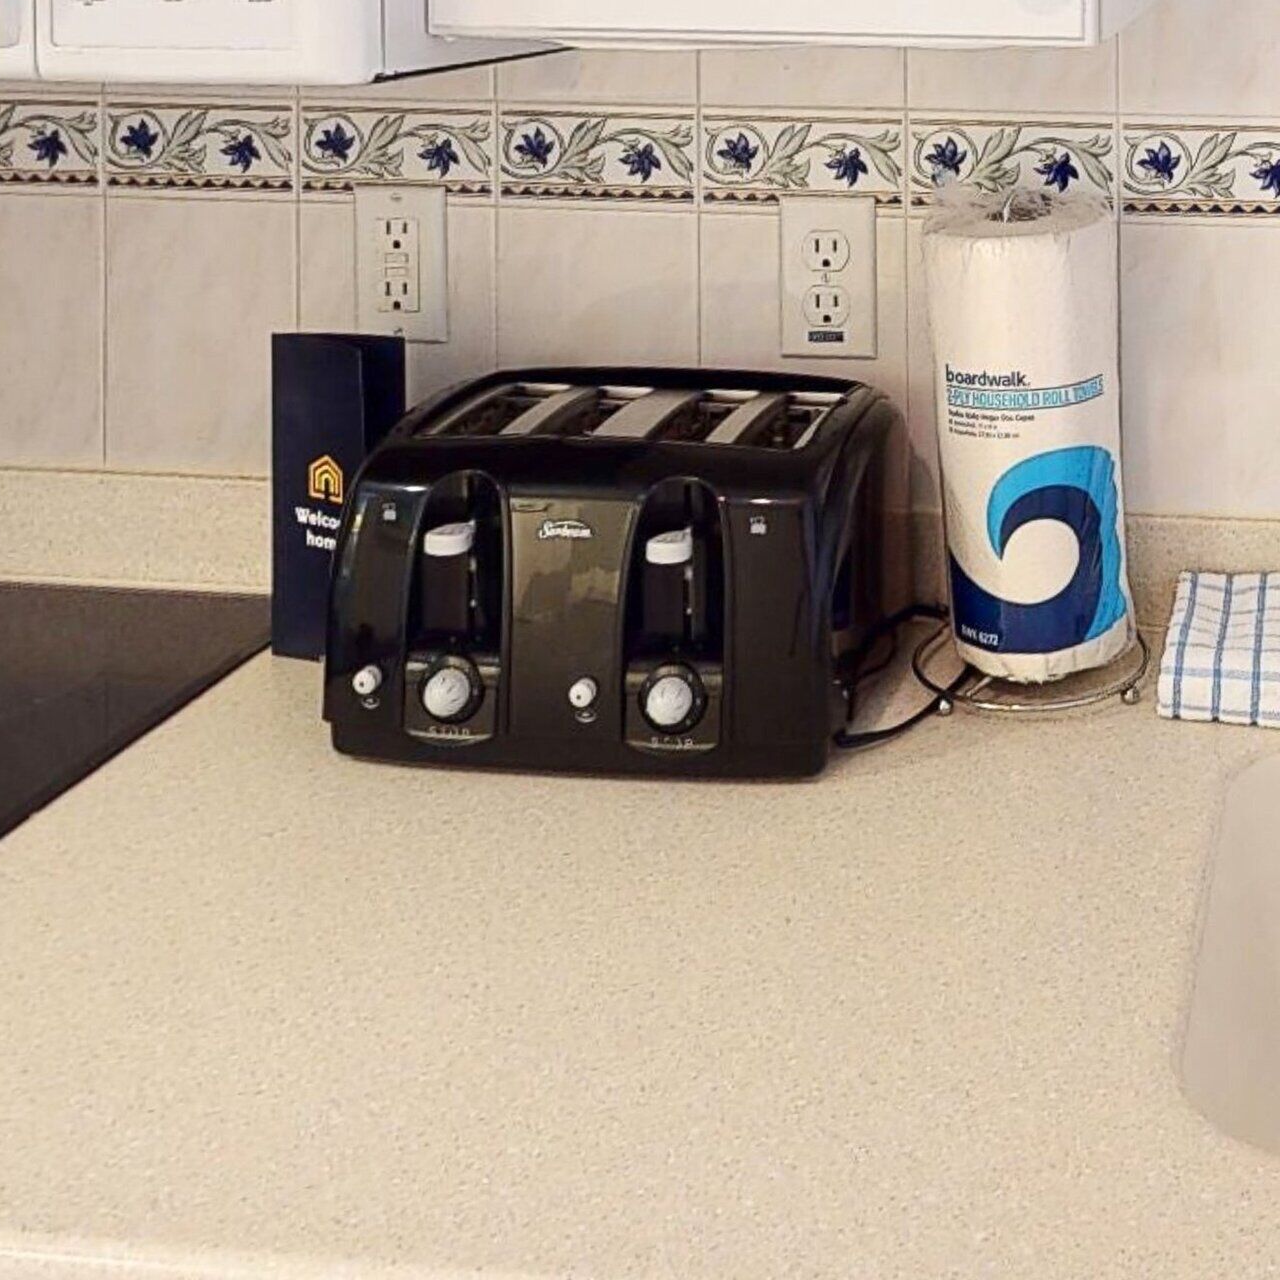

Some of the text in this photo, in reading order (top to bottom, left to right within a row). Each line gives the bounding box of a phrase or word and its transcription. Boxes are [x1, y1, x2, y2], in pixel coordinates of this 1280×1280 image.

[972, 391, 1040, 408] HOUSEHOLD
[1042, 389, 1070, 406] ROLL
[294, 505, 341, 530] Welco
[306, 528, 337, 550] hom
